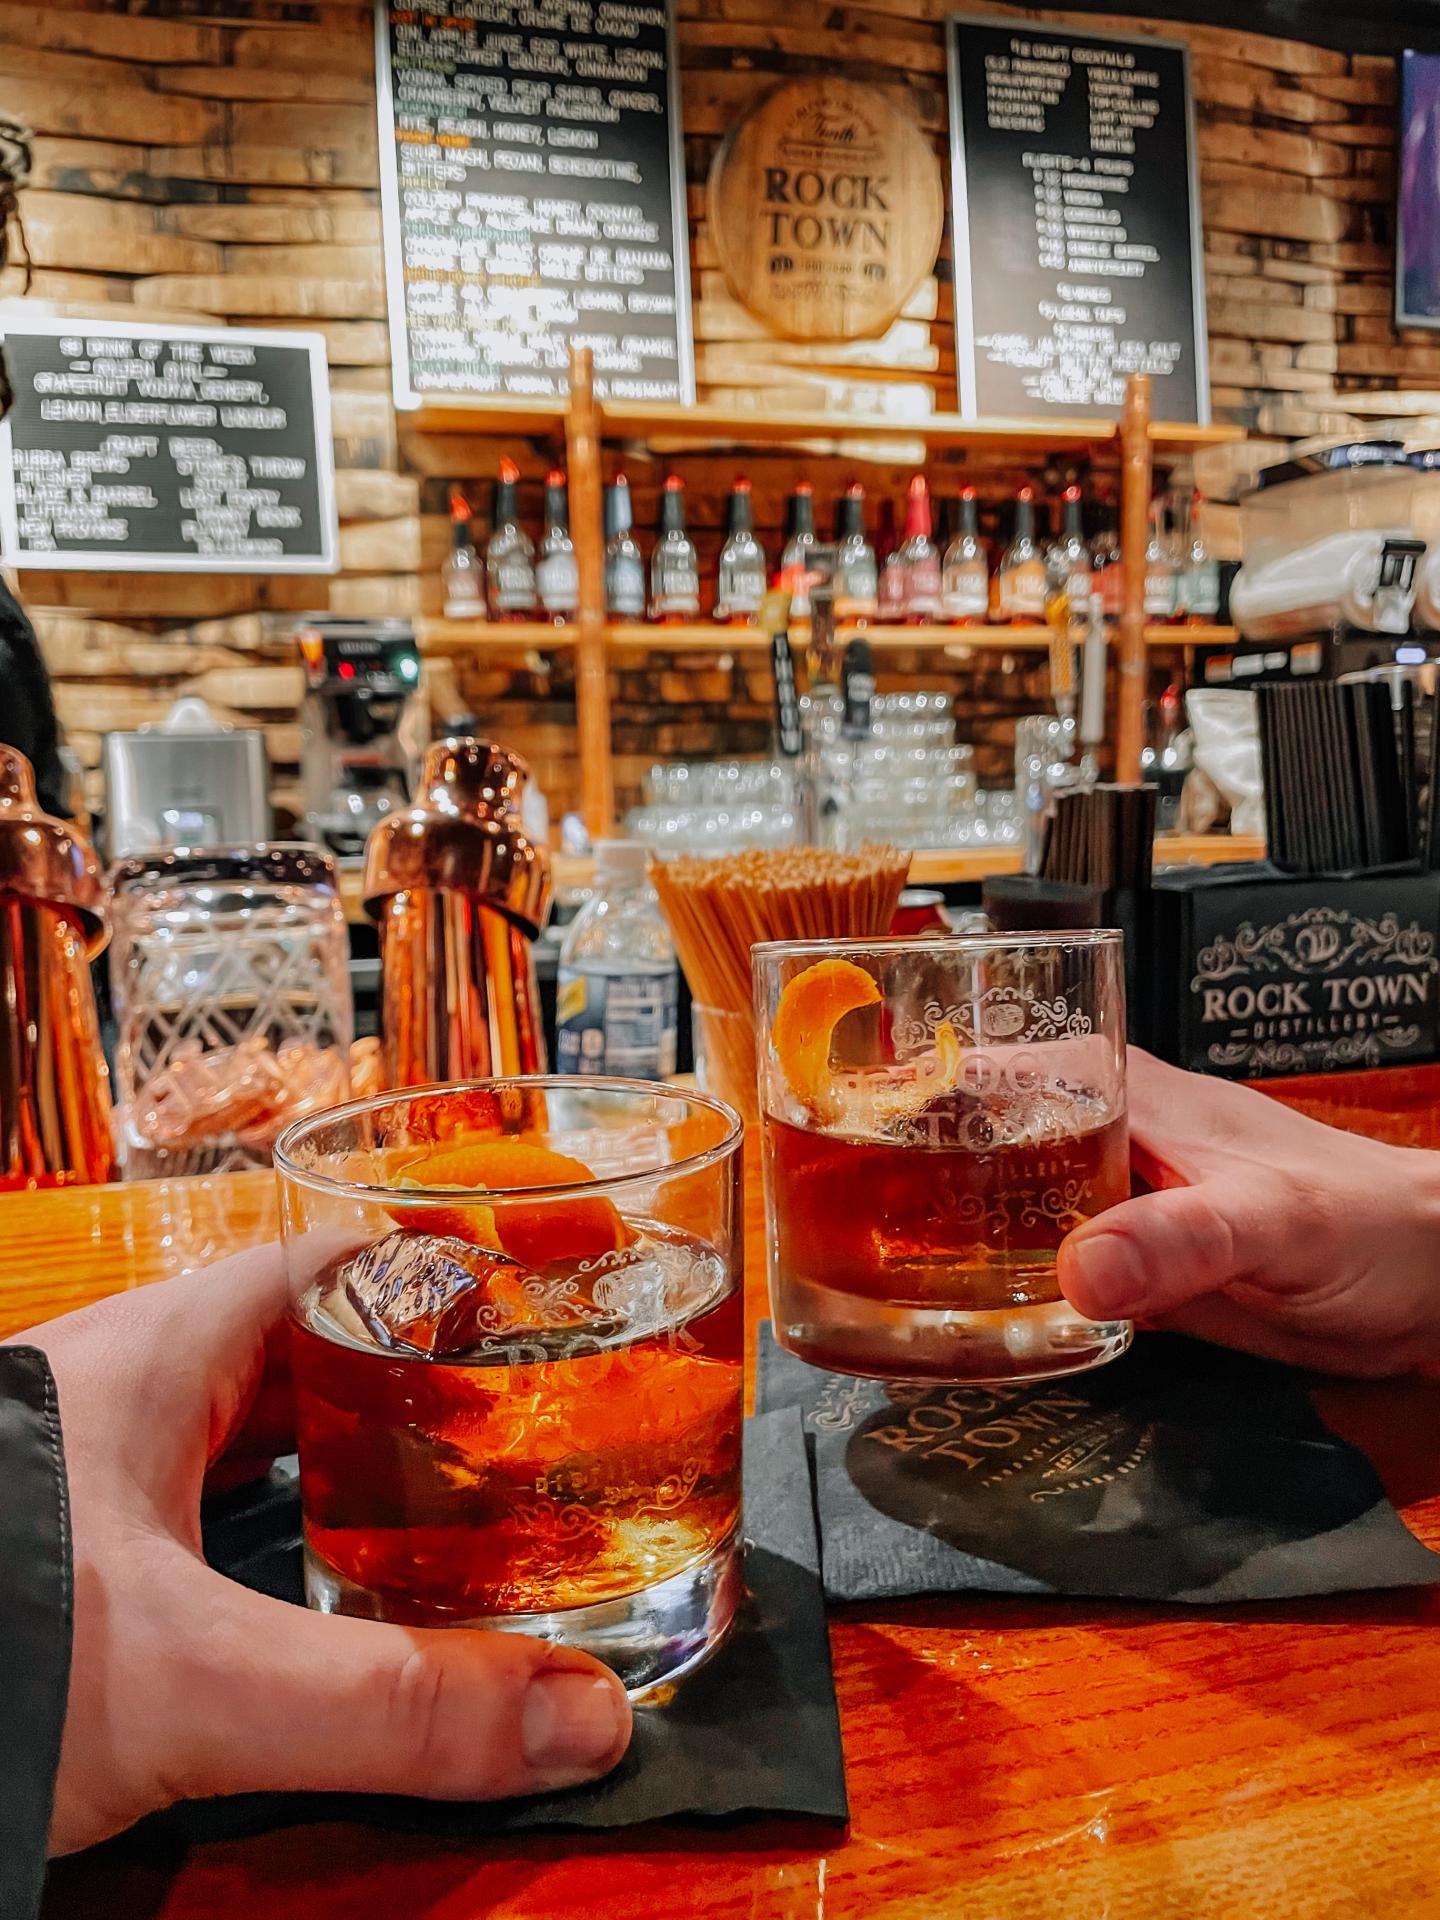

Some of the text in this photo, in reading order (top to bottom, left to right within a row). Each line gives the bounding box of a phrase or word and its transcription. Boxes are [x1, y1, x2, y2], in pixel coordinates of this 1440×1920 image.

[764, 167, 889, 211] ROCK
[761, 211, 889, 250] TOWN
[1202, 972, 1429, 1022] ROCK TOWN
[912, 1052, 1050, 1096] ROC
[920, 1391, 1090, 1471] TOWN
